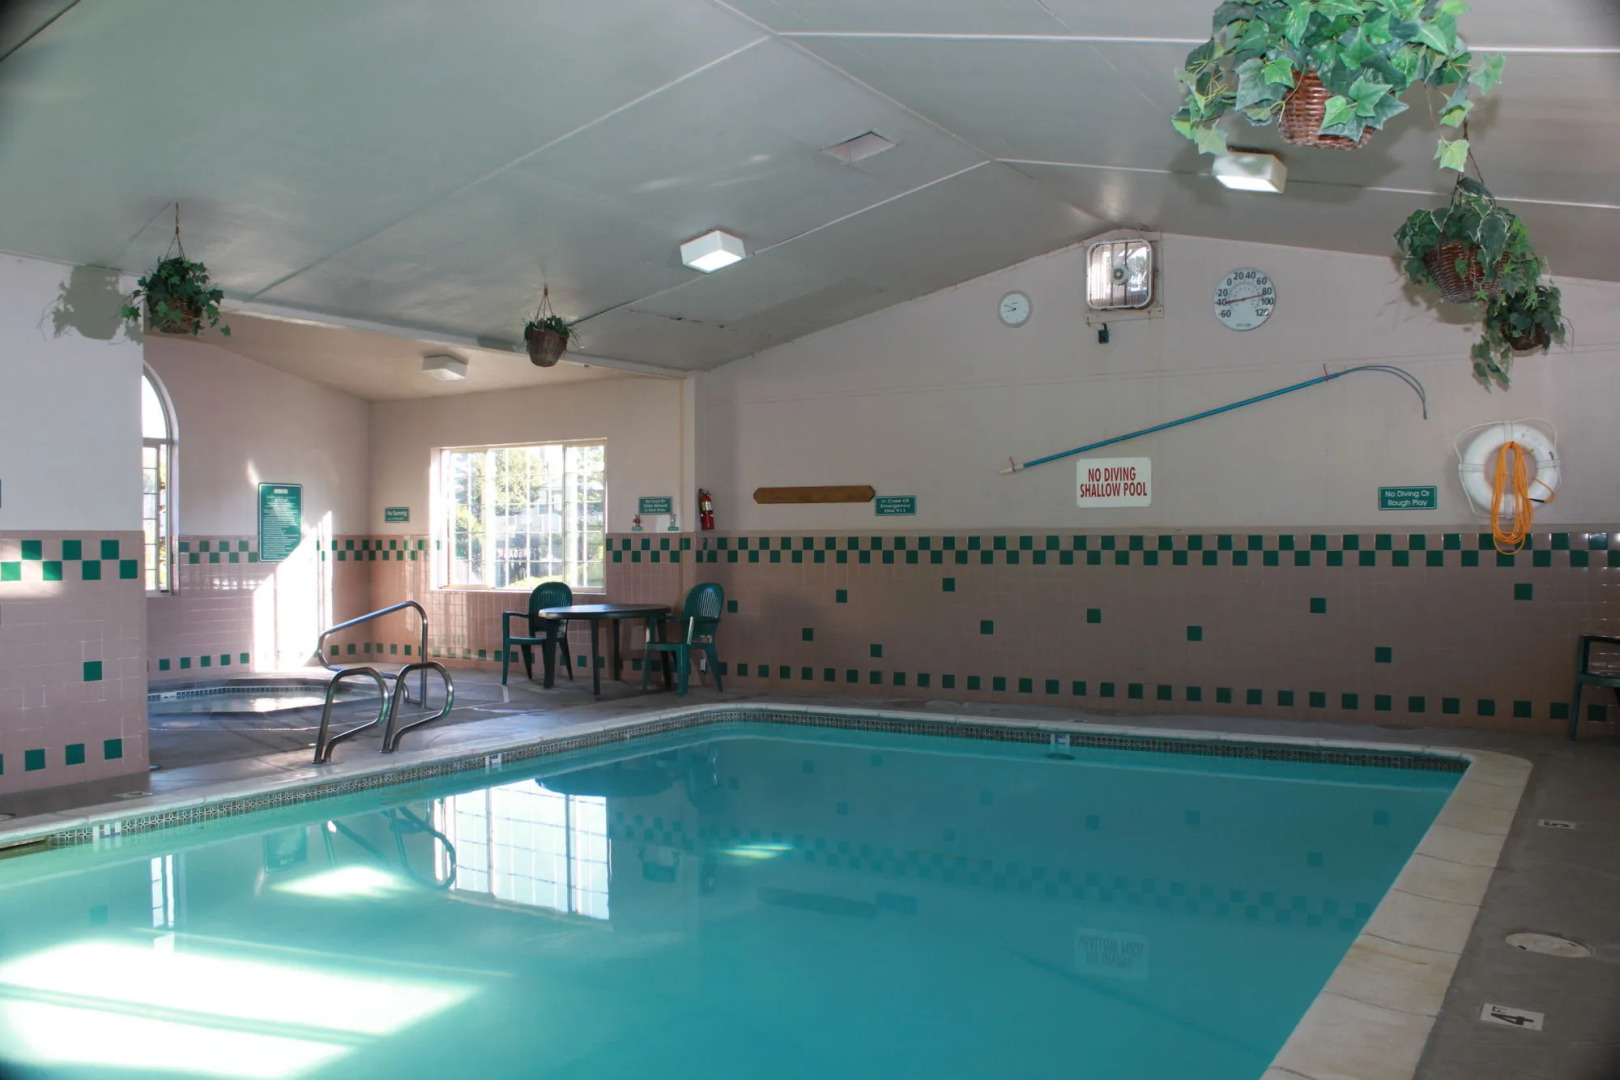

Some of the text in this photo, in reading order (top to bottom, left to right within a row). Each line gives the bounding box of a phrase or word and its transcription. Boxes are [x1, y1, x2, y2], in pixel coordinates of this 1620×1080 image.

[1233, 272, 1244, 280] 20
[1245, 271, 1256, 279] 40
[1226, 277, 1232, 286] 0
[1256, 276, 1267, 285] 60
[1261, 287, 1272, 295] 80
[1261, 297, 1275, 305] 100
[1088, 467, 1136, 482] NO DIVING
[1080, 482, 1147, 497] SHALLOW POOL
[1385, 490, 1396, 498] No
[1397, 490, 1420, 498] Diving
[1490, 1012, 1534, 1026] 4
